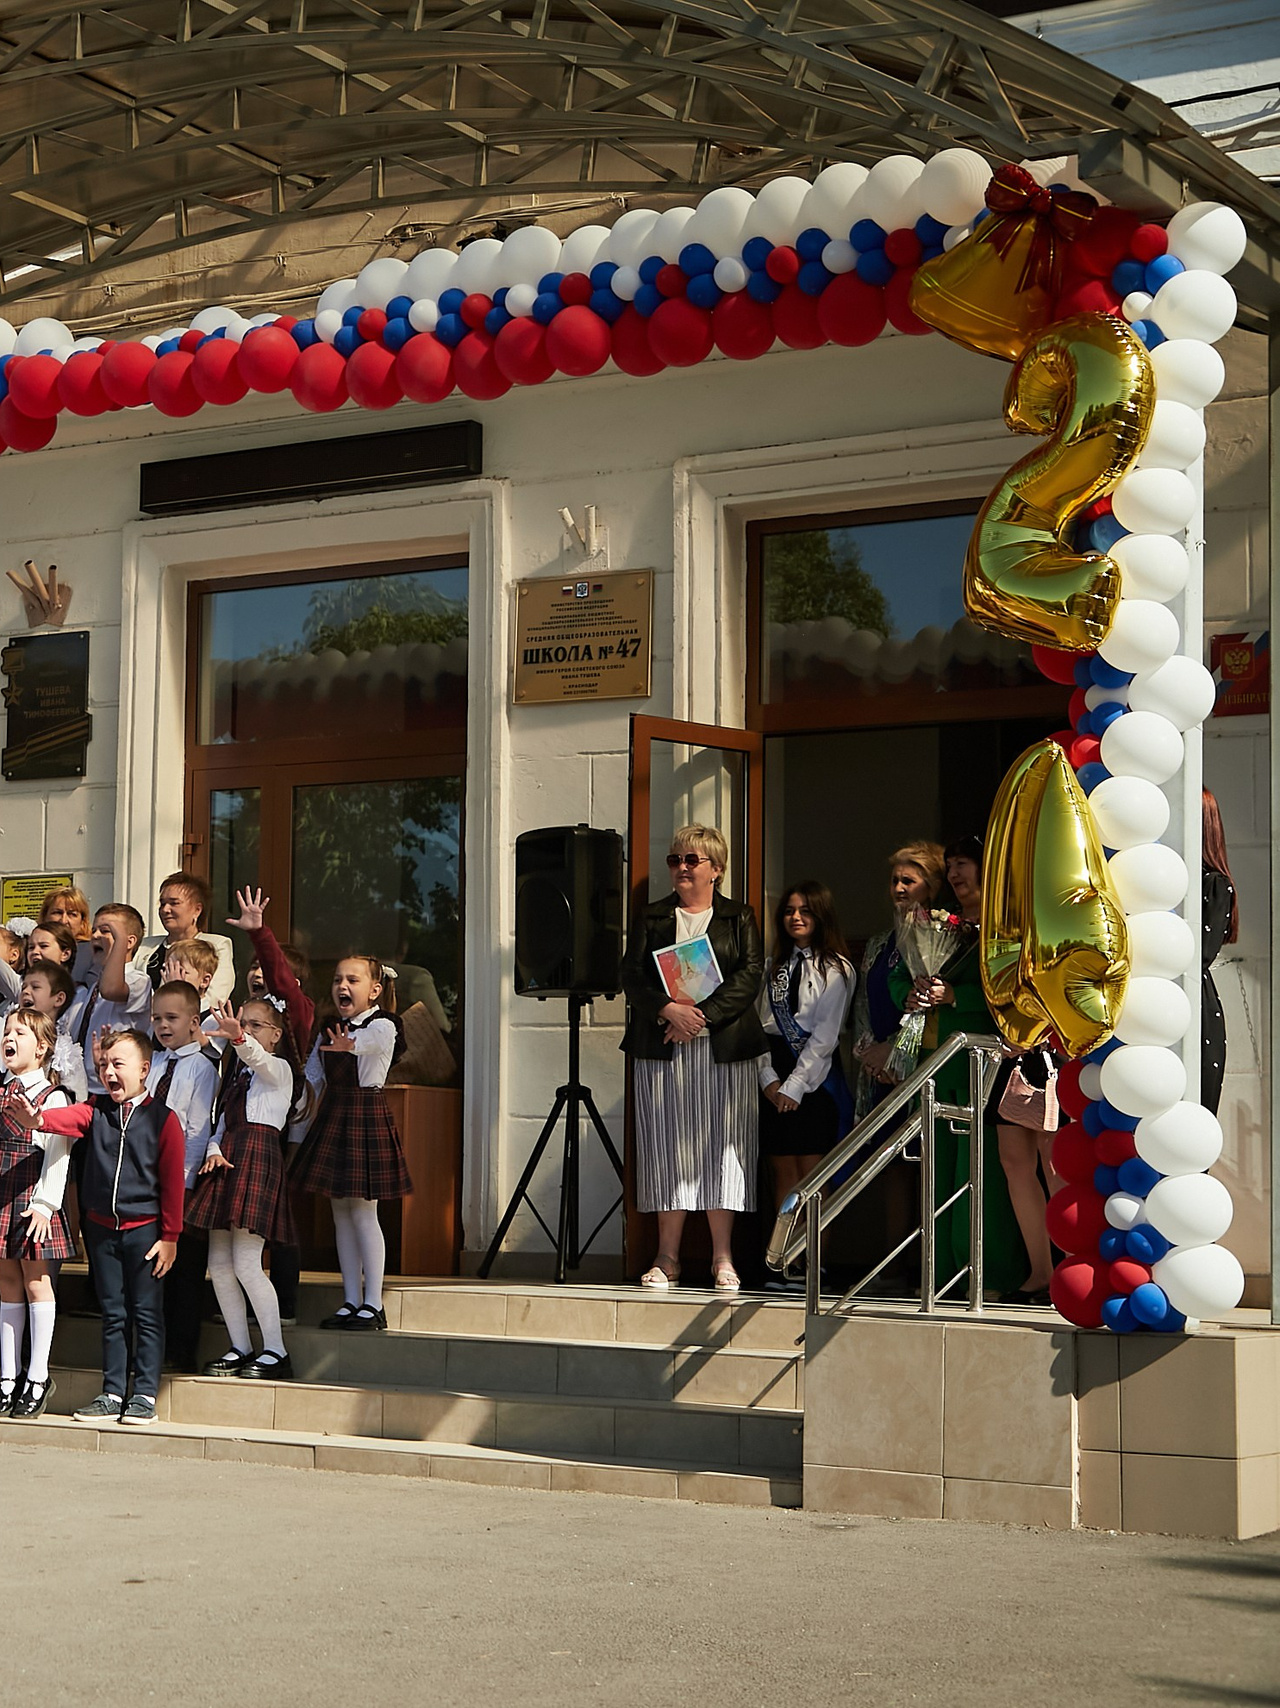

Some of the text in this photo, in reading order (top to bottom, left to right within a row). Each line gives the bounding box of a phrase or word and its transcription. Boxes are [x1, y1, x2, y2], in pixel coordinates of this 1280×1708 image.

[522, 644, 593, 665] ШКОЛА
[35, 685, 71, 697] ТУШЕВА
[1224, 692, 1269, 704] ИЗБИРАТ
